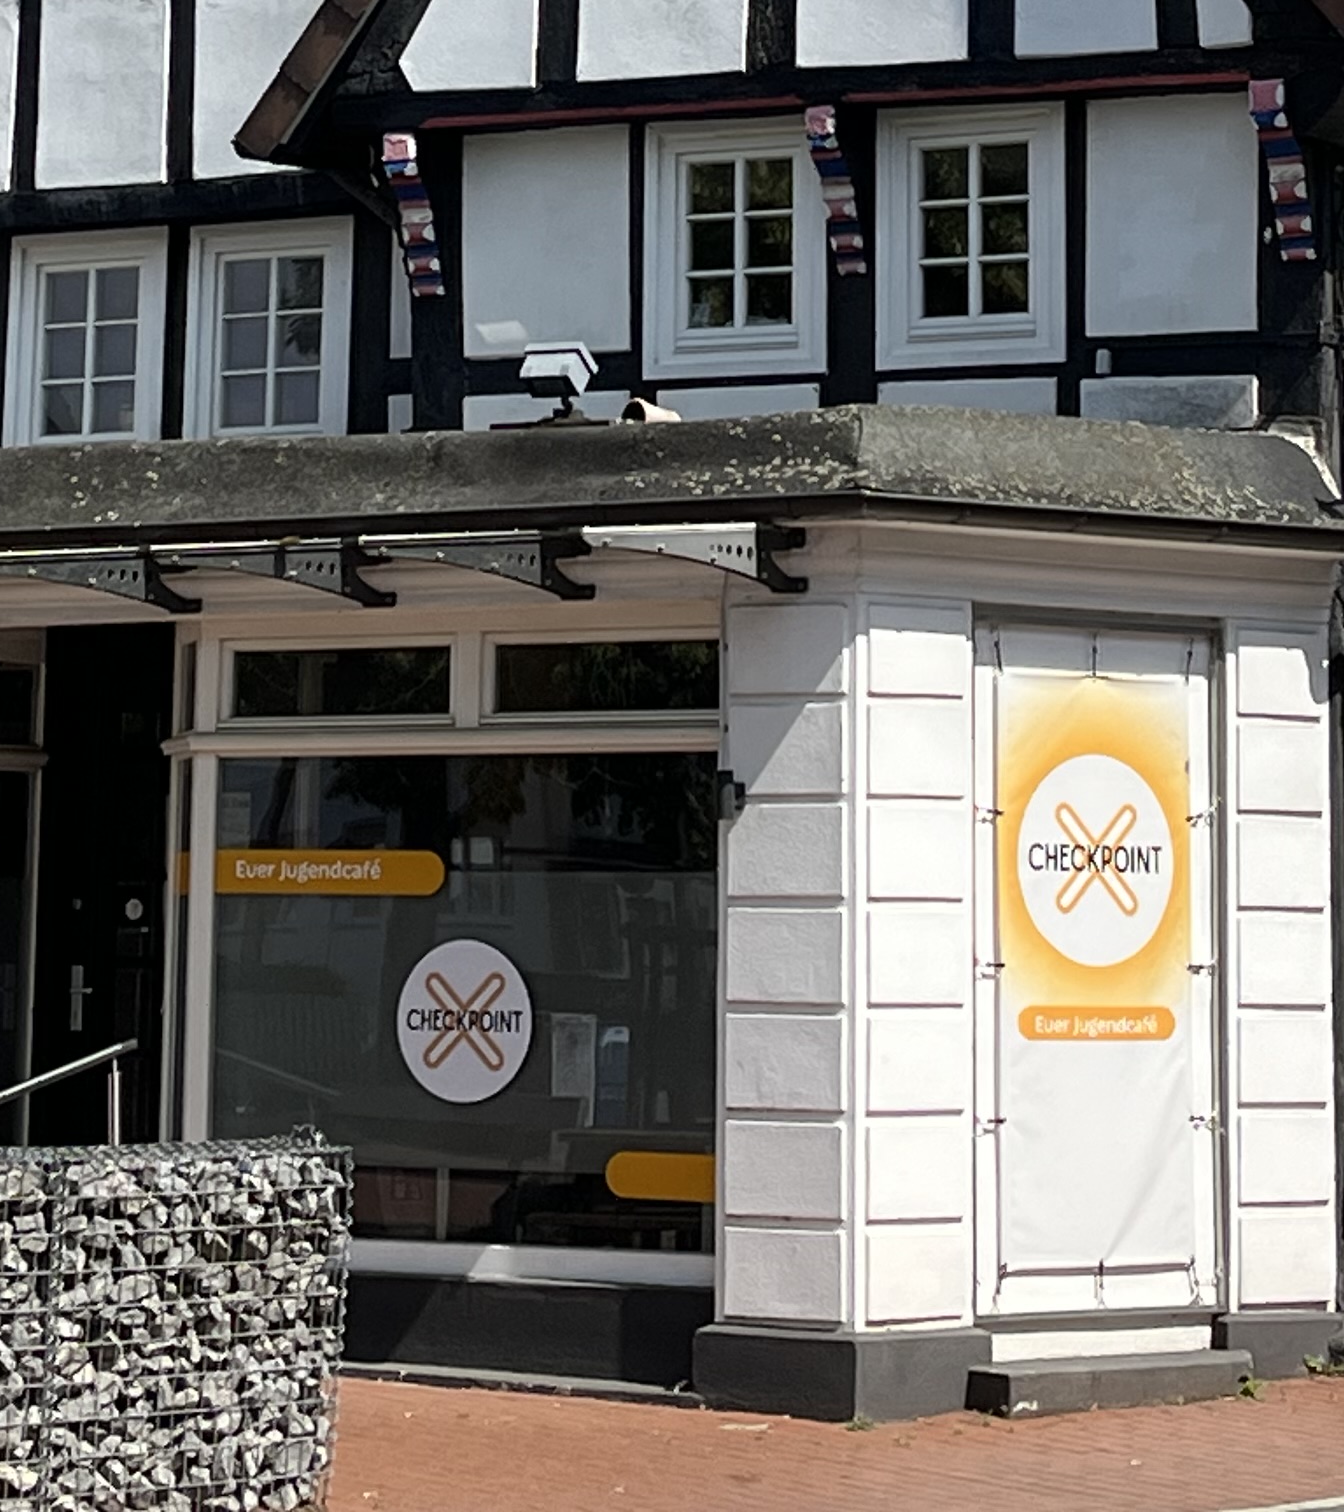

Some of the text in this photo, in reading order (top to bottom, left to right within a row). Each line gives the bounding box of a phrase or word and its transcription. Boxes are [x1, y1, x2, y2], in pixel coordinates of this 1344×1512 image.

[235, 858, 382, 884] Euer Jugendcafé
[1028, 842, 1163, 875] CHECKPOINT
[406, 1008, 524, 1033] CHECKPOINT
[1034, 1014, 1158, 1038] Euer Jugendcafé
